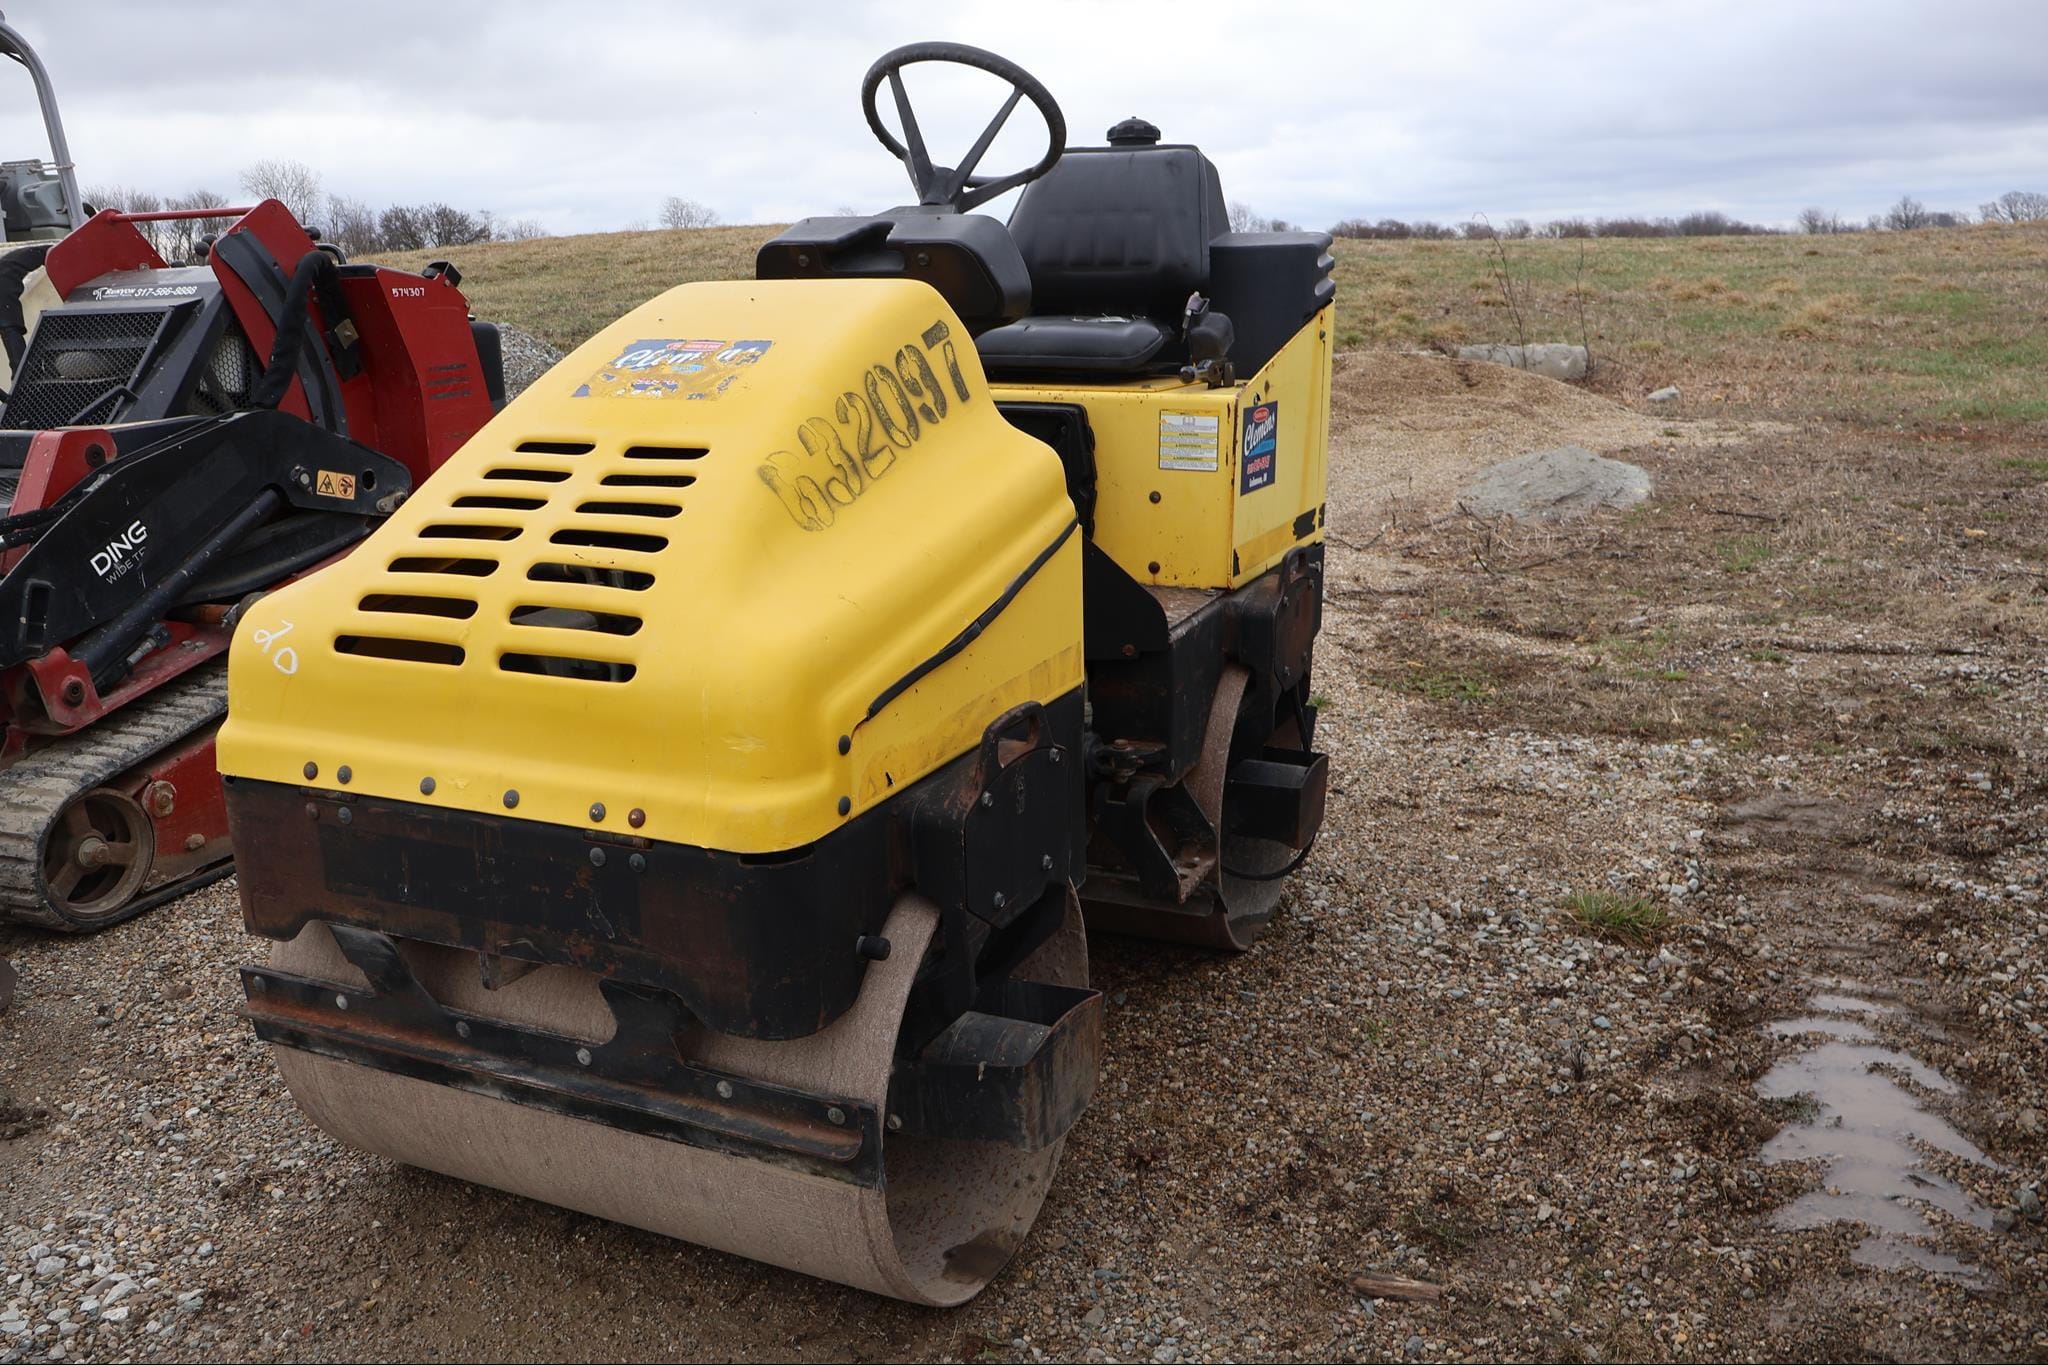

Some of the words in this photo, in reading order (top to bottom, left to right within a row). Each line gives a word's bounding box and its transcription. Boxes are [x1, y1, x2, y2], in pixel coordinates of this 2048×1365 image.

[391, 287, 425, 297] 574307
[756, 319, 970, 532] 632097
[106, 558, 134, 585] WIDE
